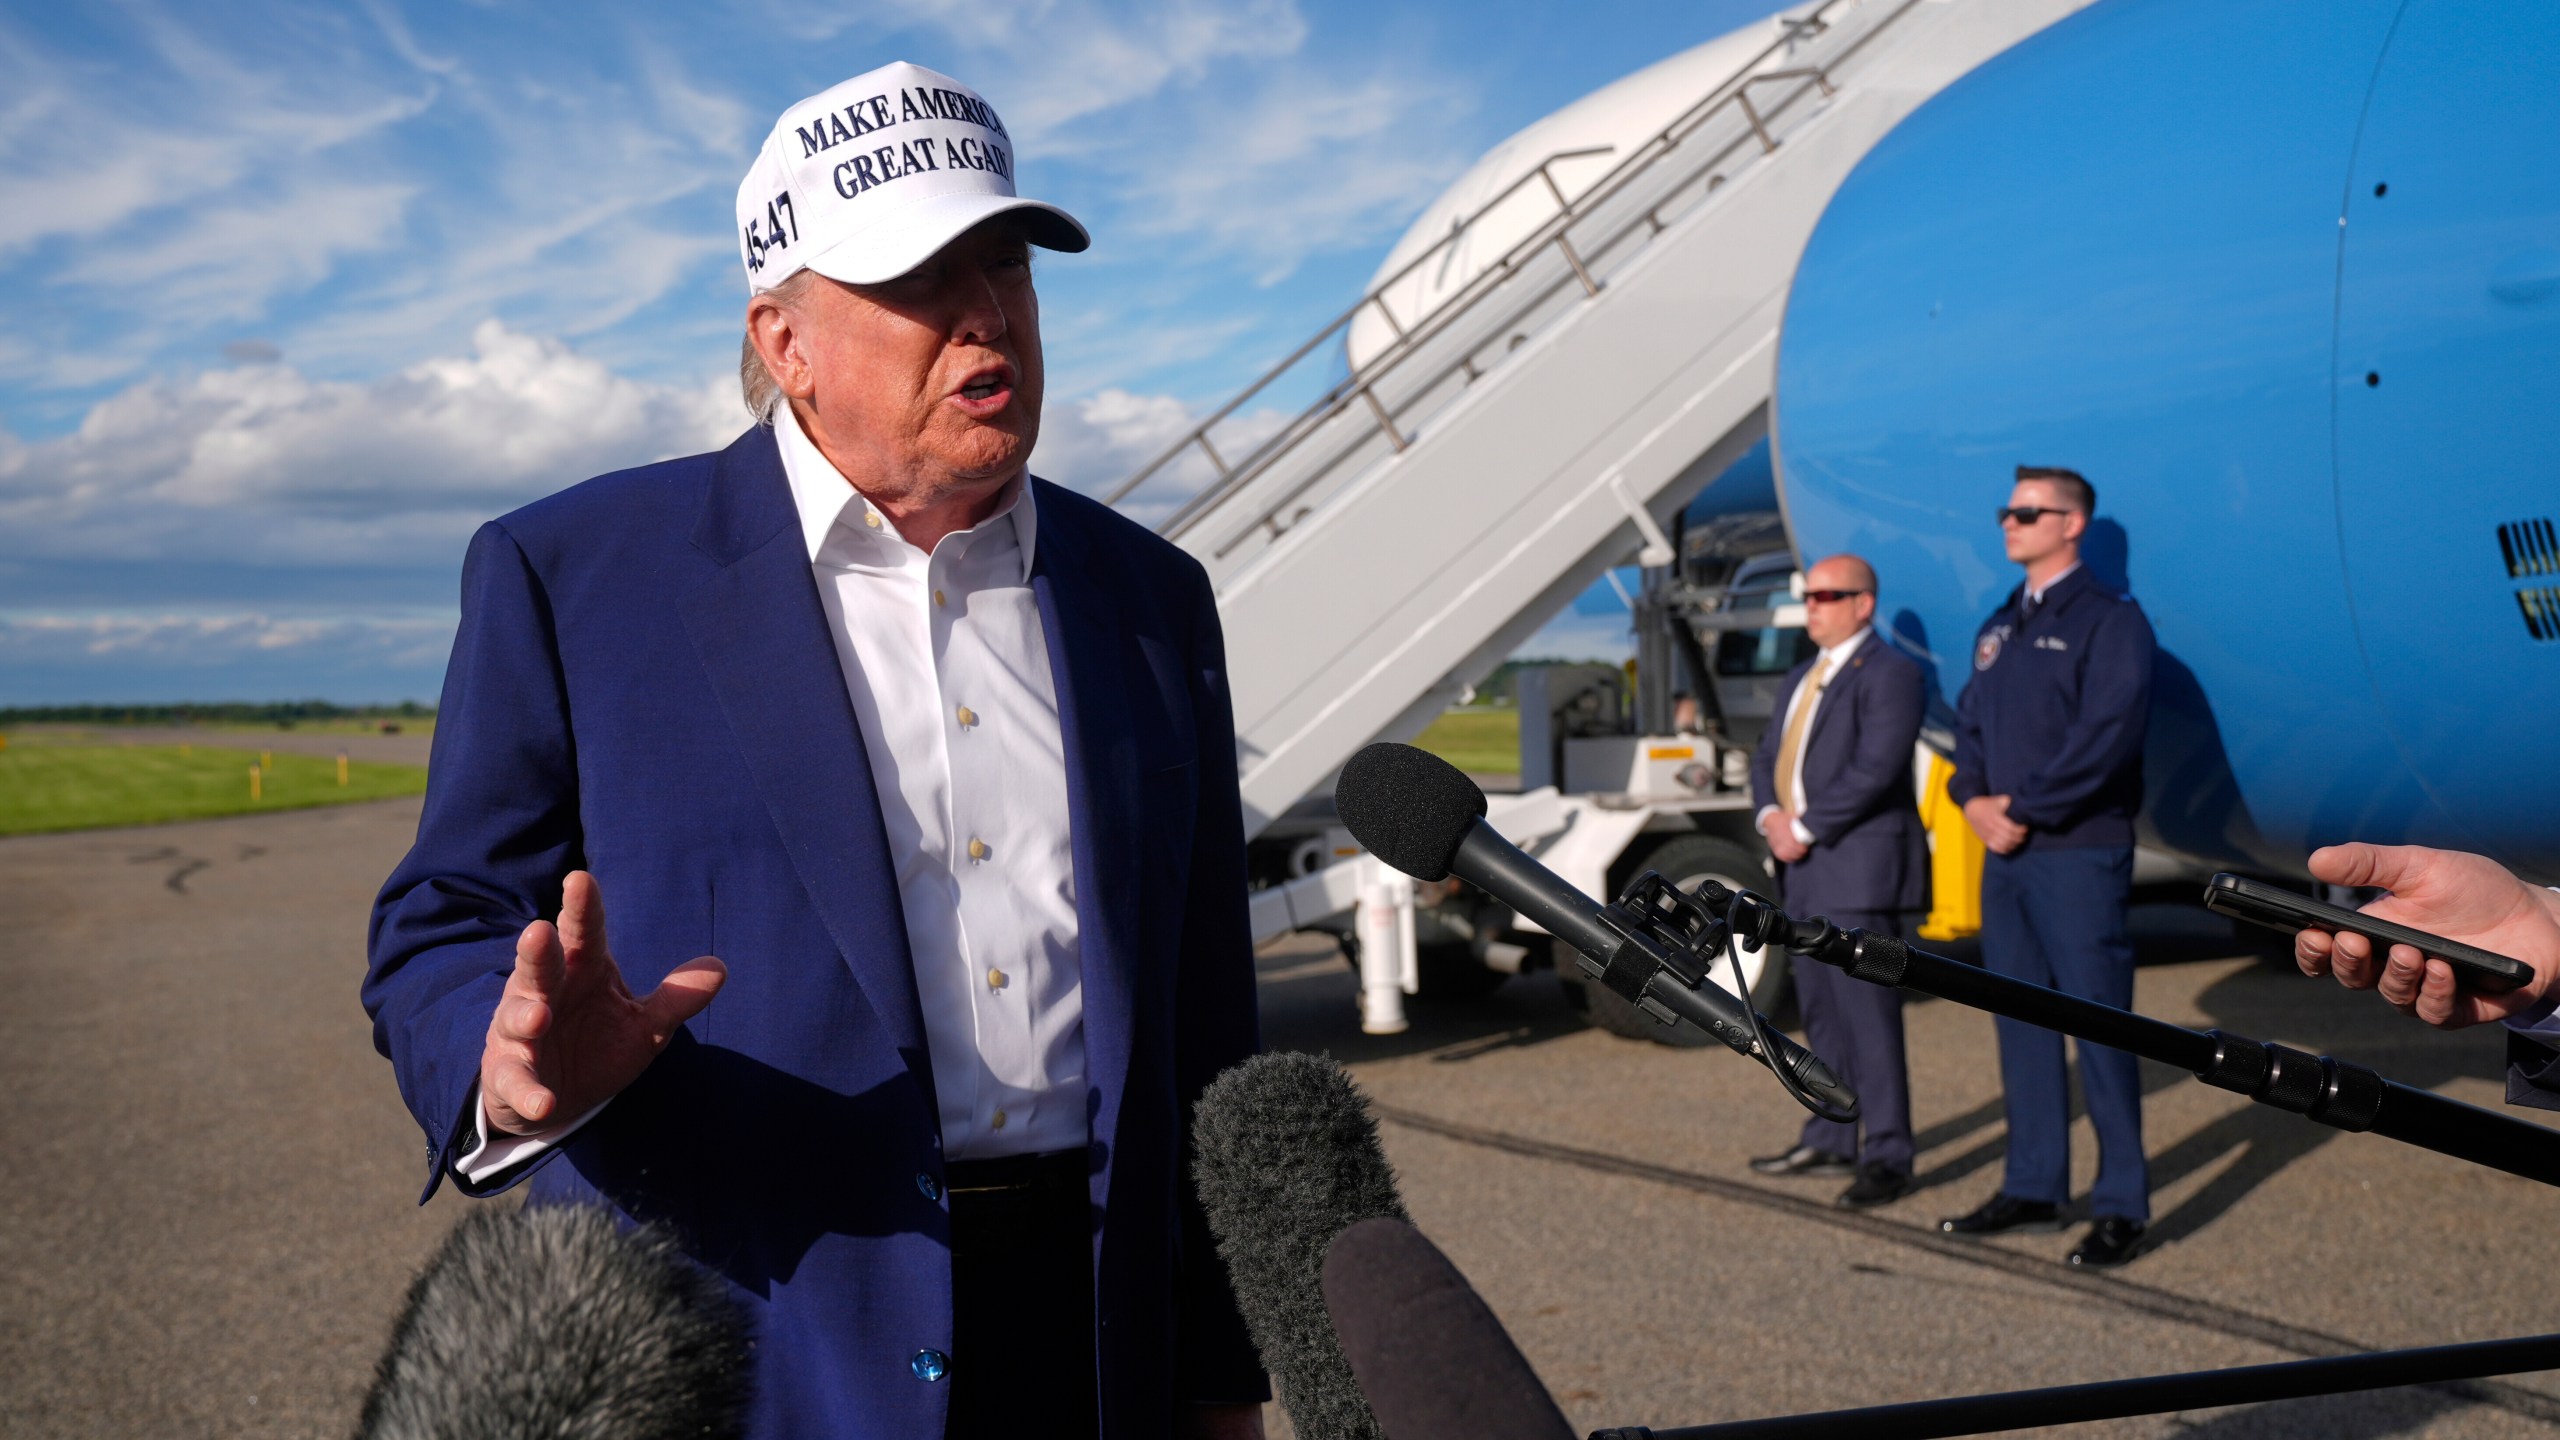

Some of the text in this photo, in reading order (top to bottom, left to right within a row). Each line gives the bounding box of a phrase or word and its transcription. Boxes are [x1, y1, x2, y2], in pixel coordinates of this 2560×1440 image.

[795, 94, 896, 159] MAKE
[833, 138, 940, 200] GREAT
[745, 190, 799, 274] 45-47
